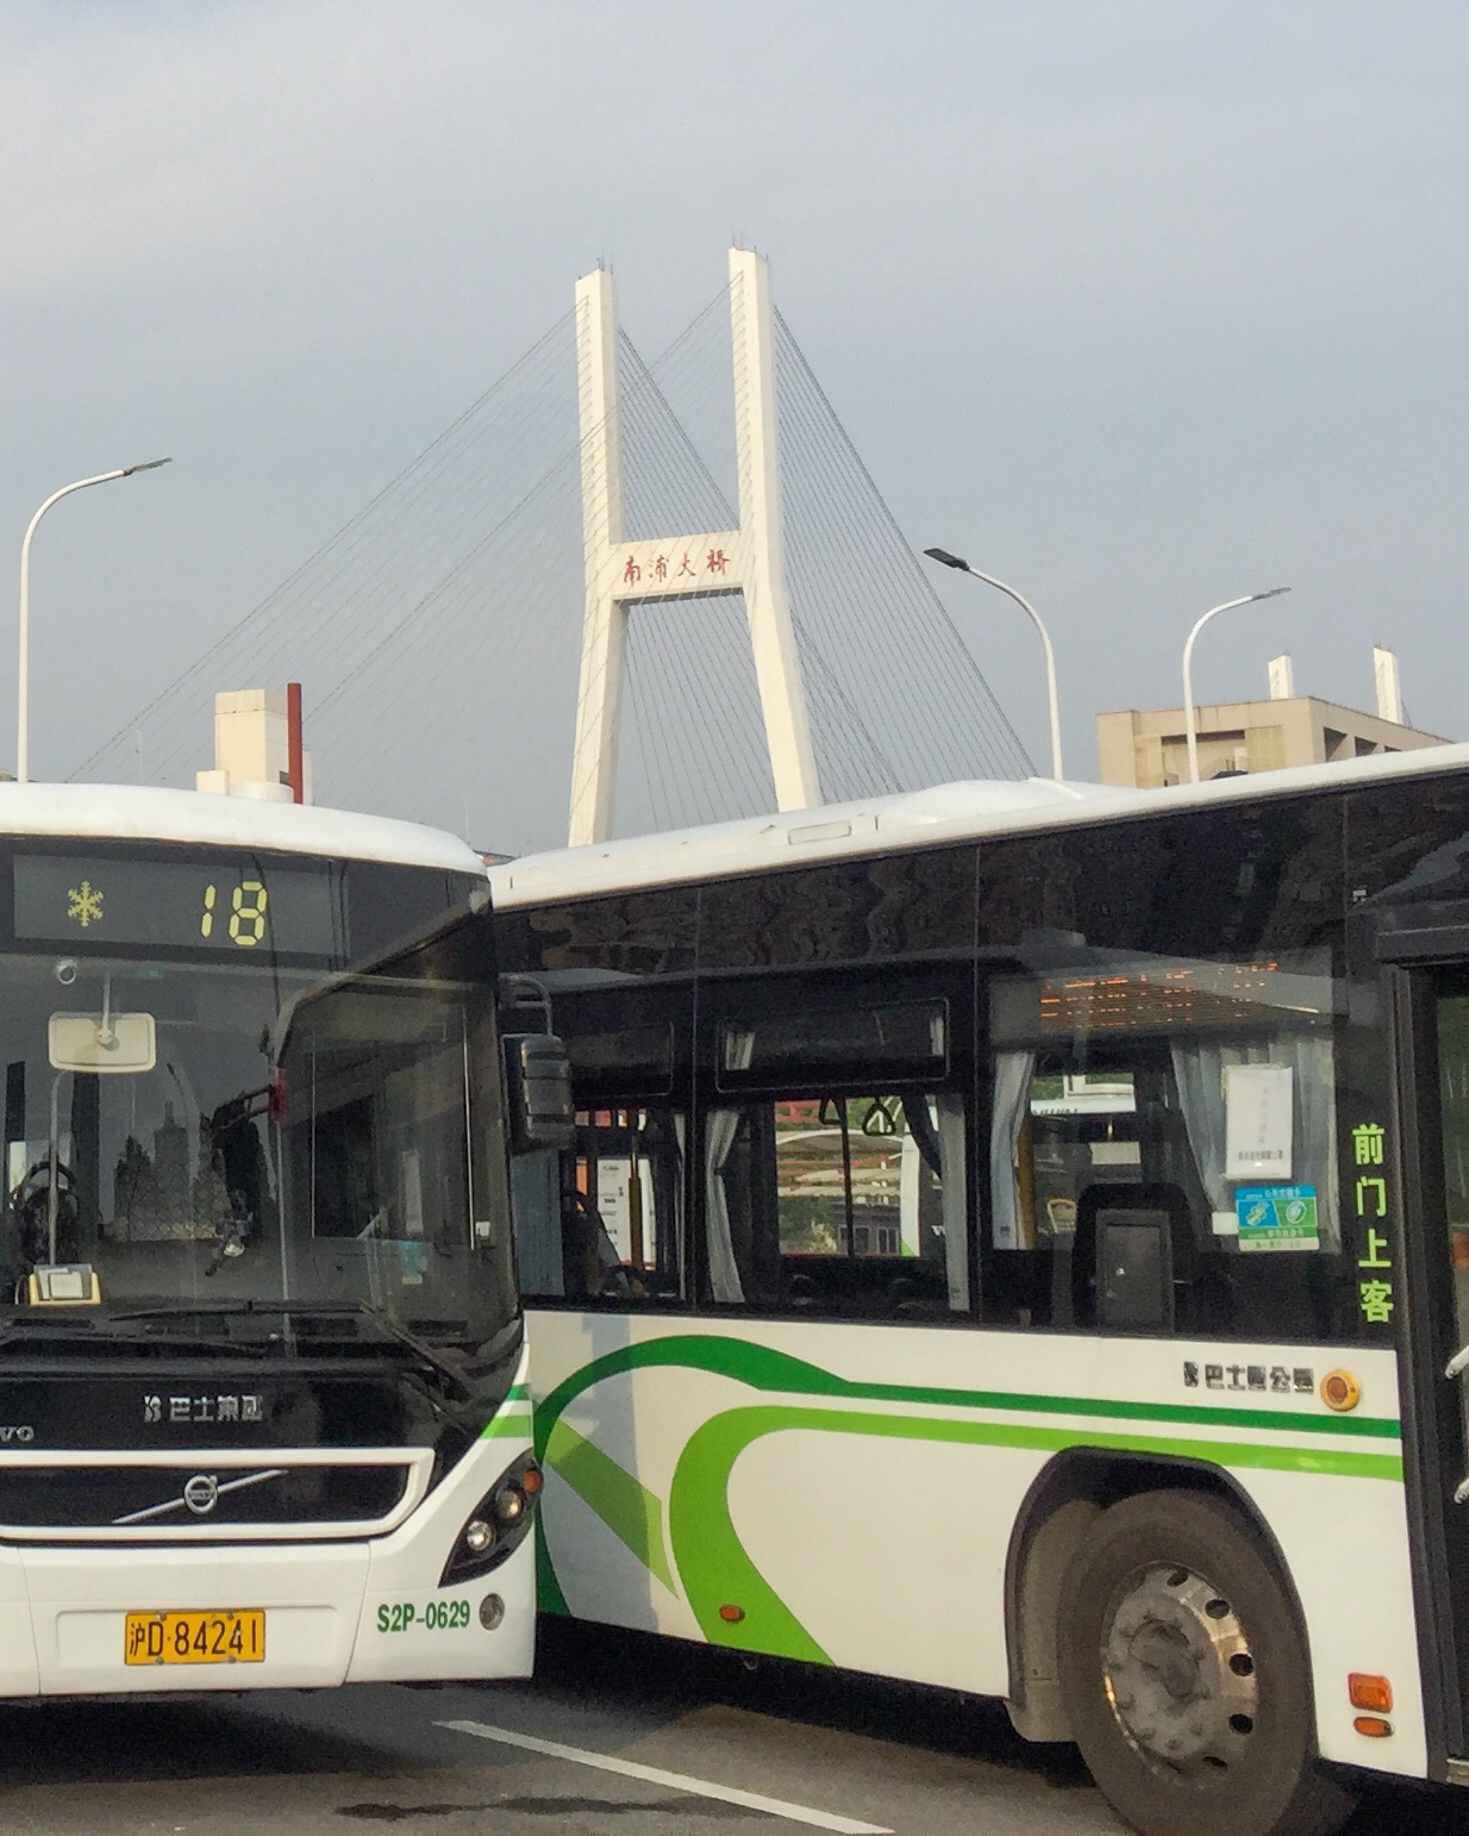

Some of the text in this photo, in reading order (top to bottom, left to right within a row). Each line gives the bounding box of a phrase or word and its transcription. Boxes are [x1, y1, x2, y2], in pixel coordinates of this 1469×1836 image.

[623, 549, 731, 588] 南浦大桥
[200, 881, 268, 947] 18
[1352, 1123, 1395, 1323] 前门上客
[169, 1394, 263, 1422] 巴士集团
[377, 1600, 471, 1633] S2P-0629
